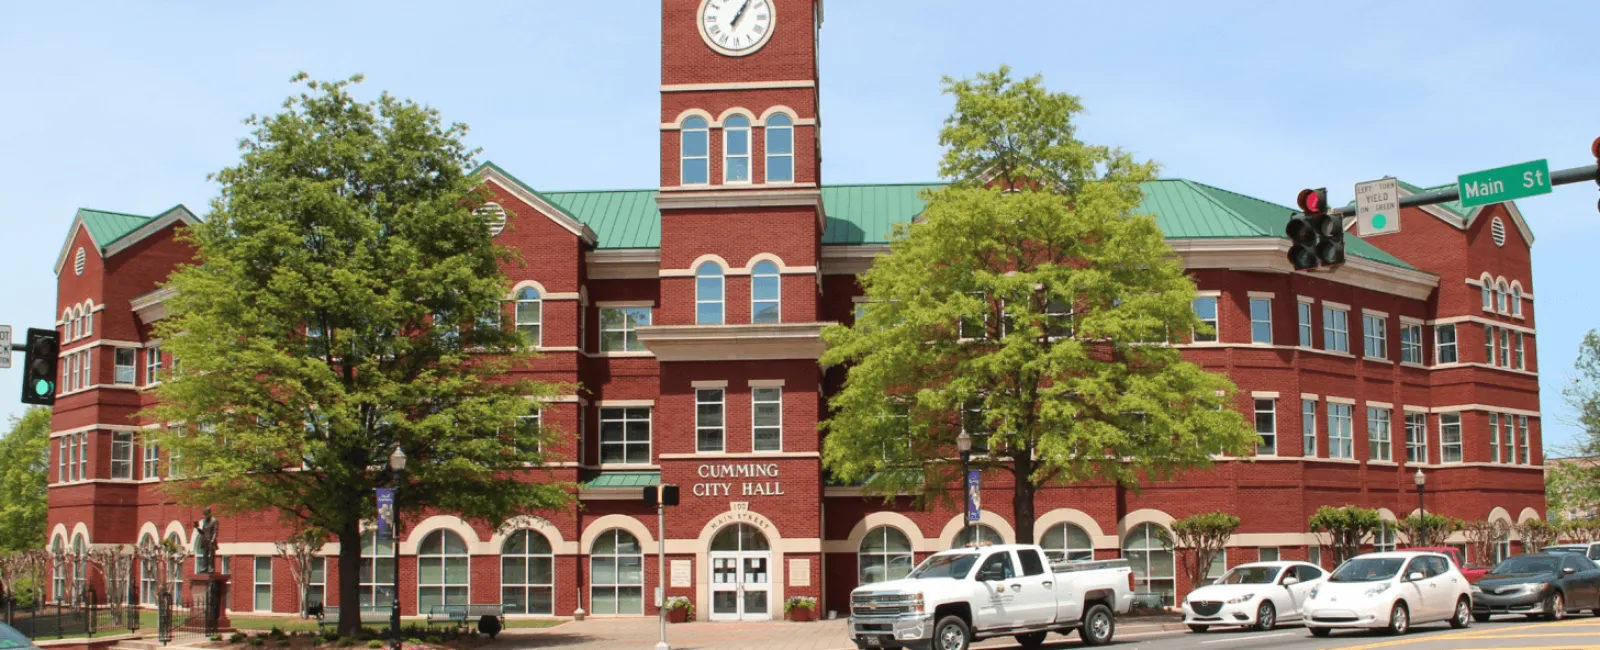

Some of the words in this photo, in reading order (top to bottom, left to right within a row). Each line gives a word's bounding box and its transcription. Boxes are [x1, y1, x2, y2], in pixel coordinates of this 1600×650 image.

[1379, 182, 1394, 190] TURN
[1465, 177, 1504, 199] Main
[1523, 170, 1544, 188] St
[1366, 193, 1389, 203] YIELD
[1376, 203, 1395, 211] GREEN
[0, 331, 9, 341] OT
[698, 464, 779, 478] CUMMING
[693, 483, 732, 496] CITY
[742, 482, 784, 496] HALL
[711, 514, 733, 530] MAIN
[738, 514, 769, 530] STREET
